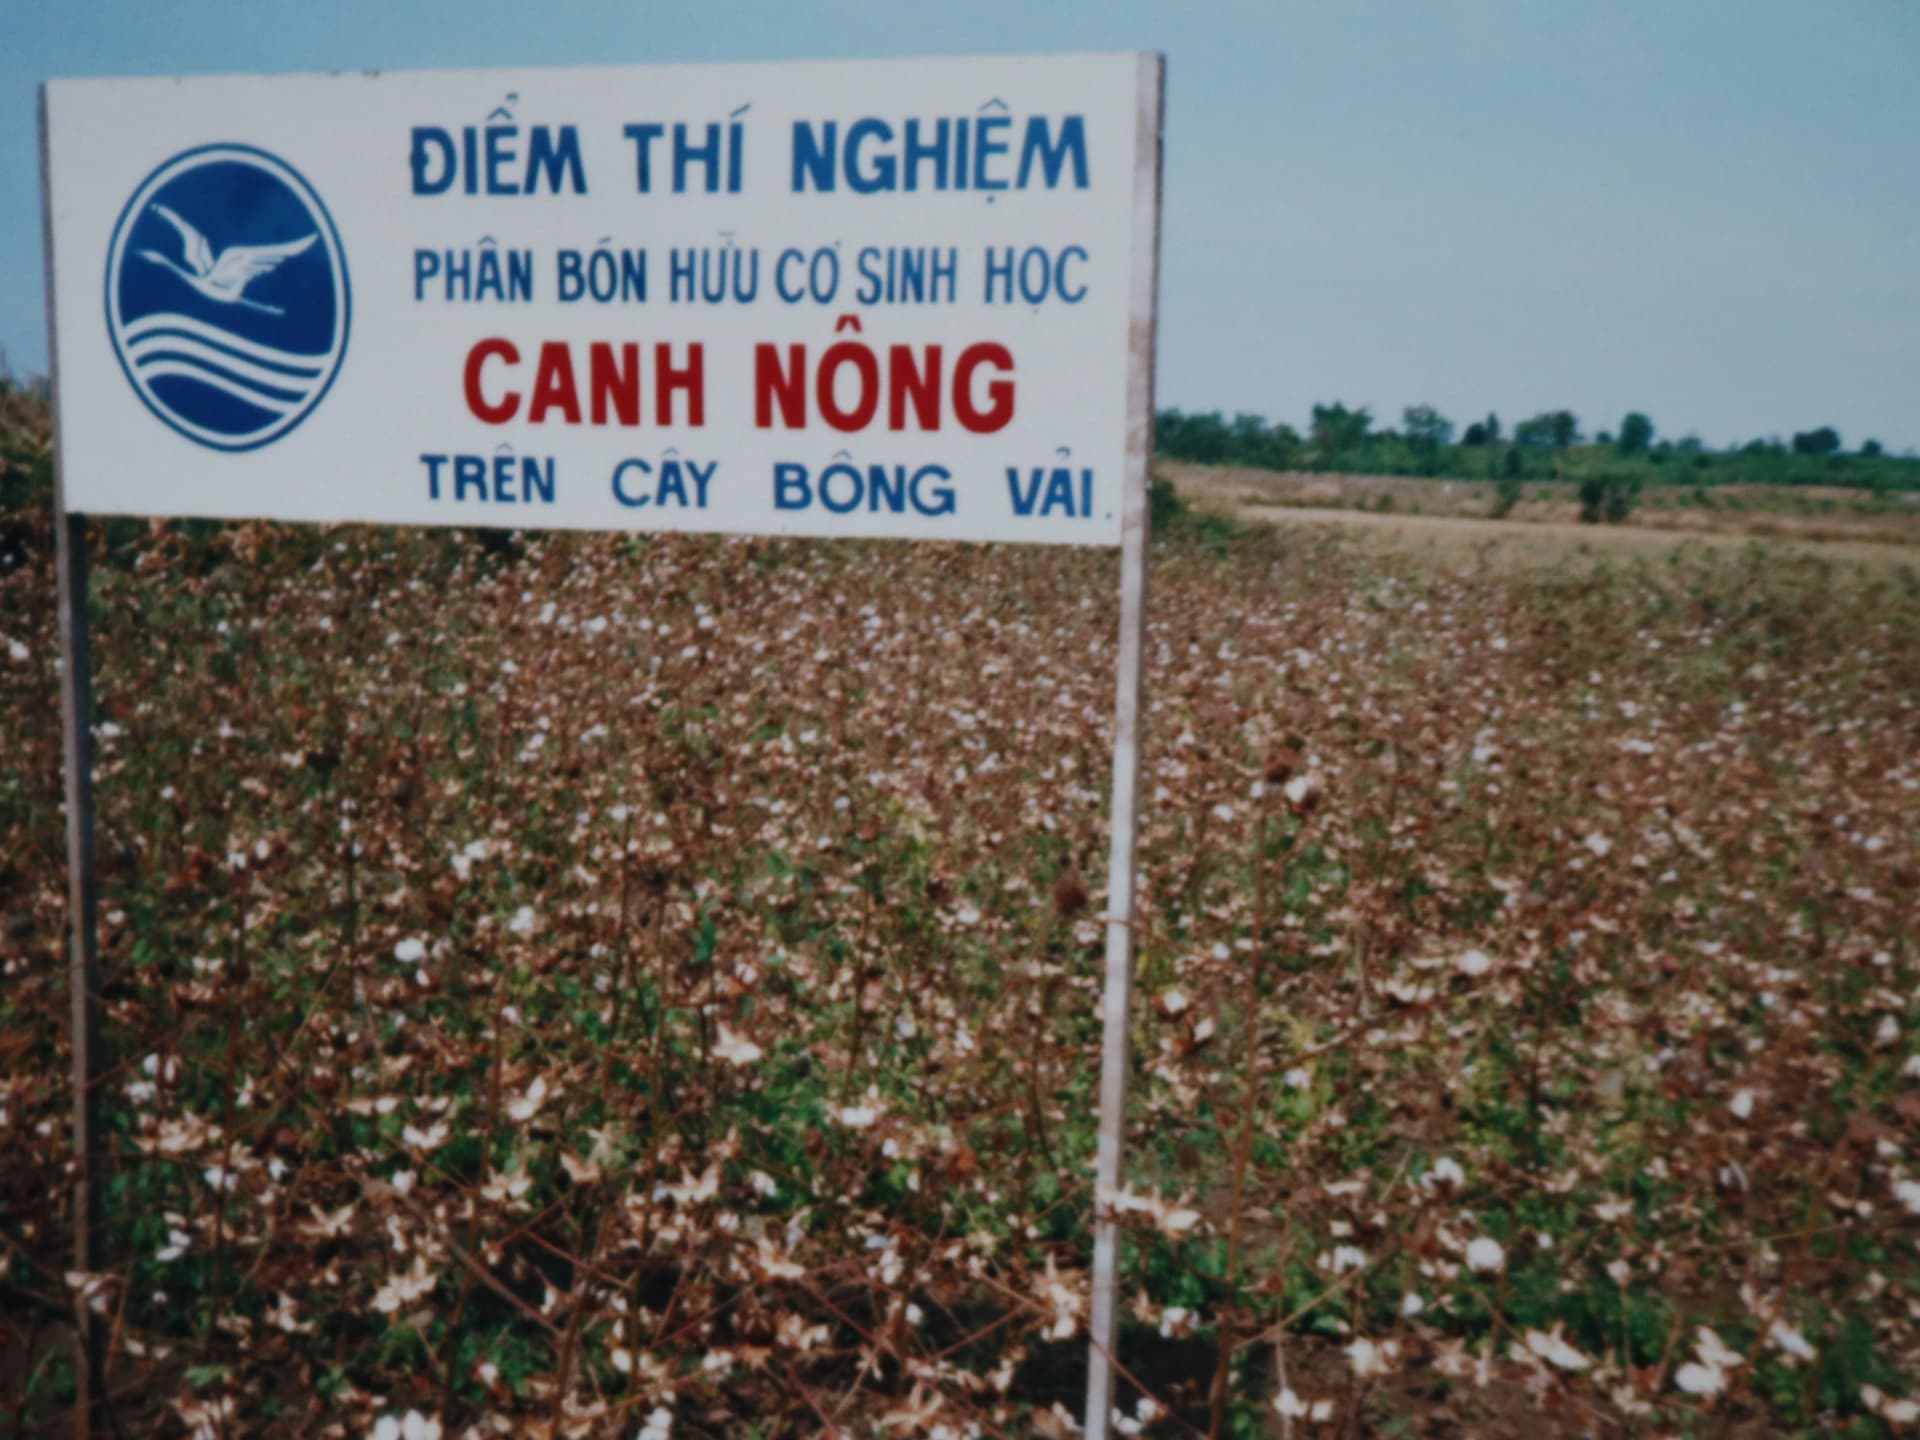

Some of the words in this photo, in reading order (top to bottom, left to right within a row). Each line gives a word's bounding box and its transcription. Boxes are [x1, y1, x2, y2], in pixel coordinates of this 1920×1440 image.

[409, 92, 589, 197] ĐIỂM
[623, 104, 752, 194] THÍ
[791, 97, 1090, 203] NGHIỆM
[413, 235, 534, 303] PHÂN
[557, 236, 648, 304] BÓN
[775, 240, 841, 306] CƠ
[856, 246, 957, 306] SINH
[984, 245, 1089, 315] HỌC
[463, 336, 705, 428] CANH
[754, 314, 1016, 435] NÔNG
[419, 443, 556, 504] TRÊN
[611, 447, 719, 509] CÂY
[773, 450, 957, 518] BÔNG
